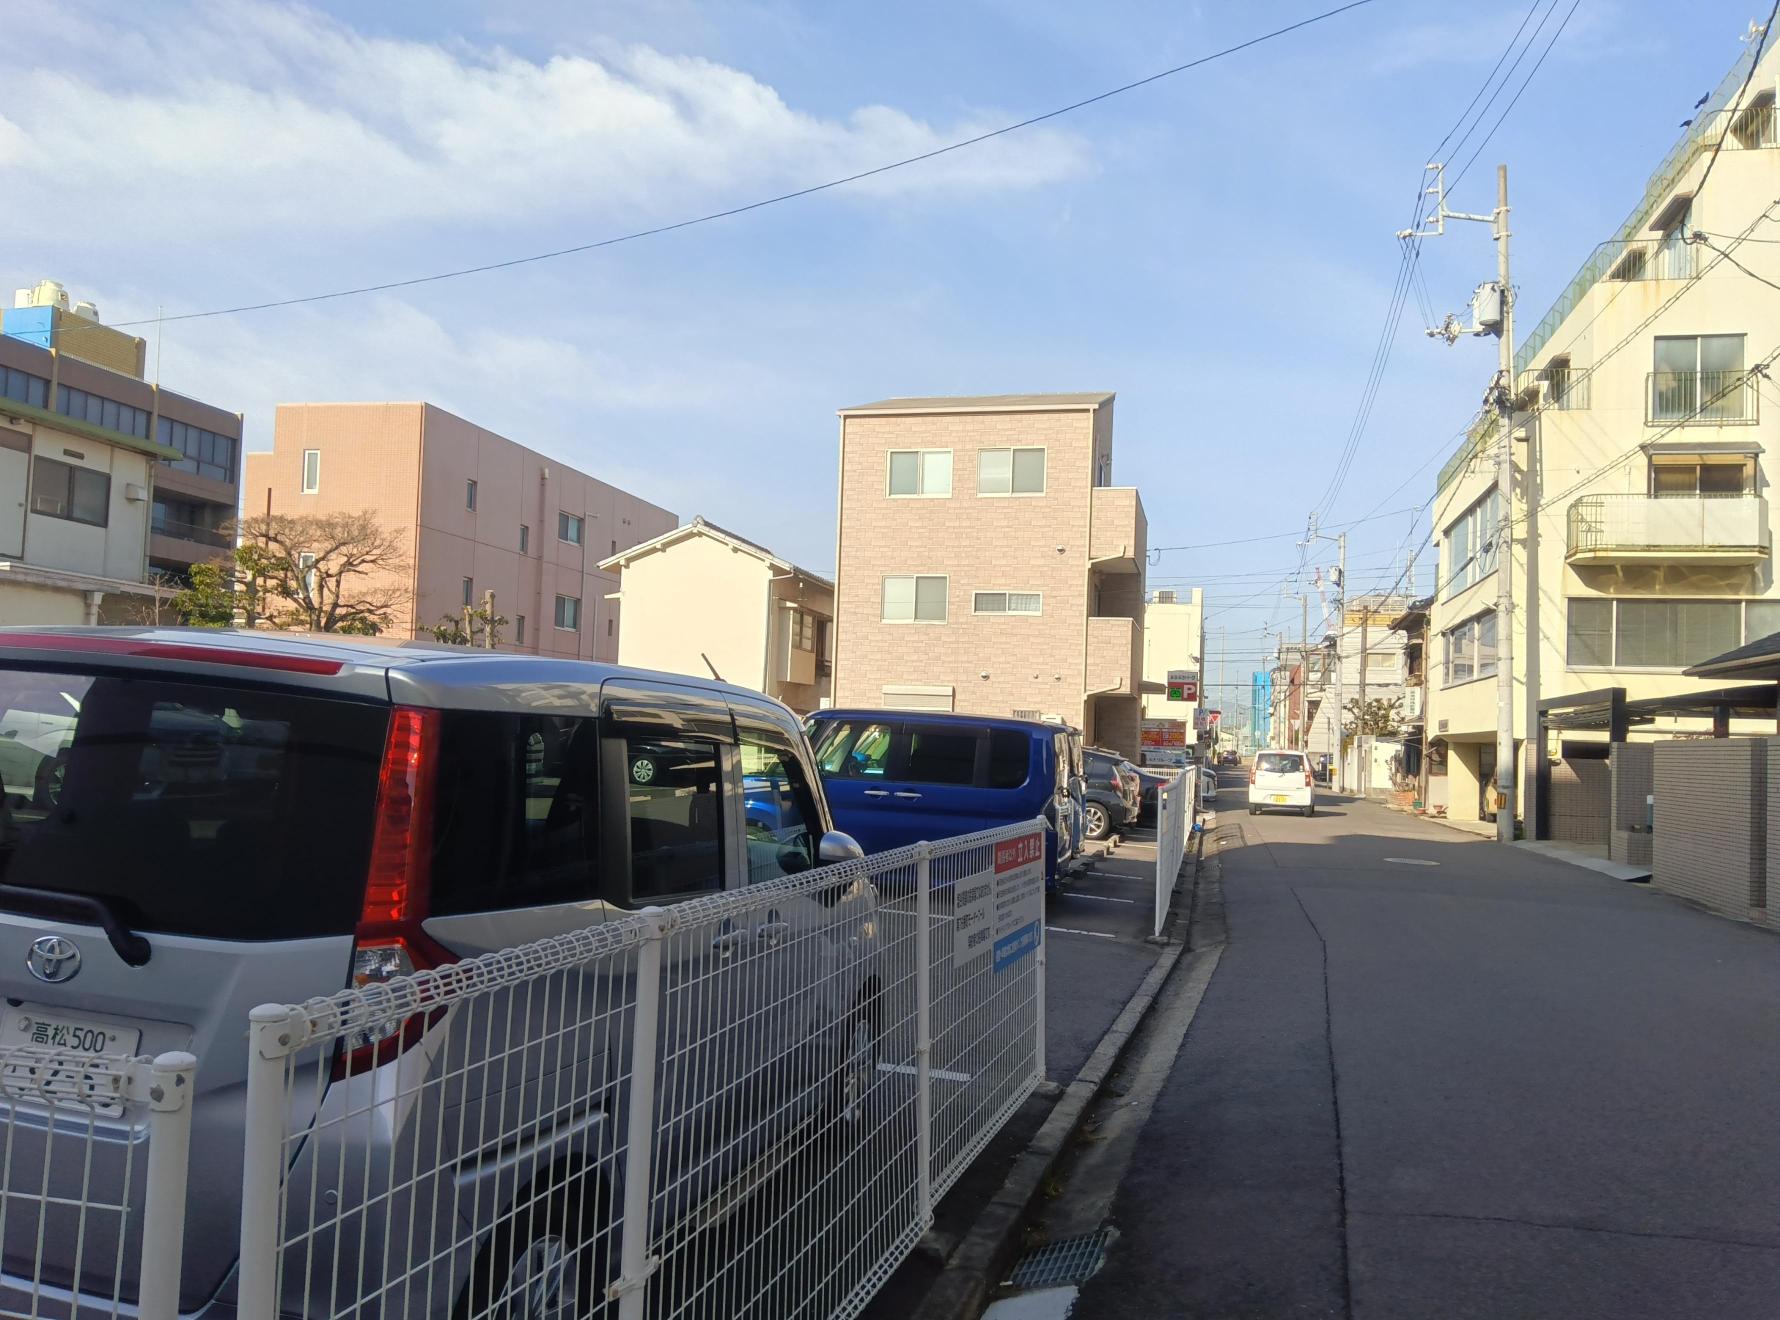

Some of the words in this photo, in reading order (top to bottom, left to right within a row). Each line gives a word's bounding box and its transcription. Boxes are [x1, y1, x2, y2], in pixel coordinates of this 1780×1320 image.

[1184, 685, 1195, 698] P
[1017, 837, 1040, 863] 立入禁止
[31, 1021, 106, 1053] 高松500
